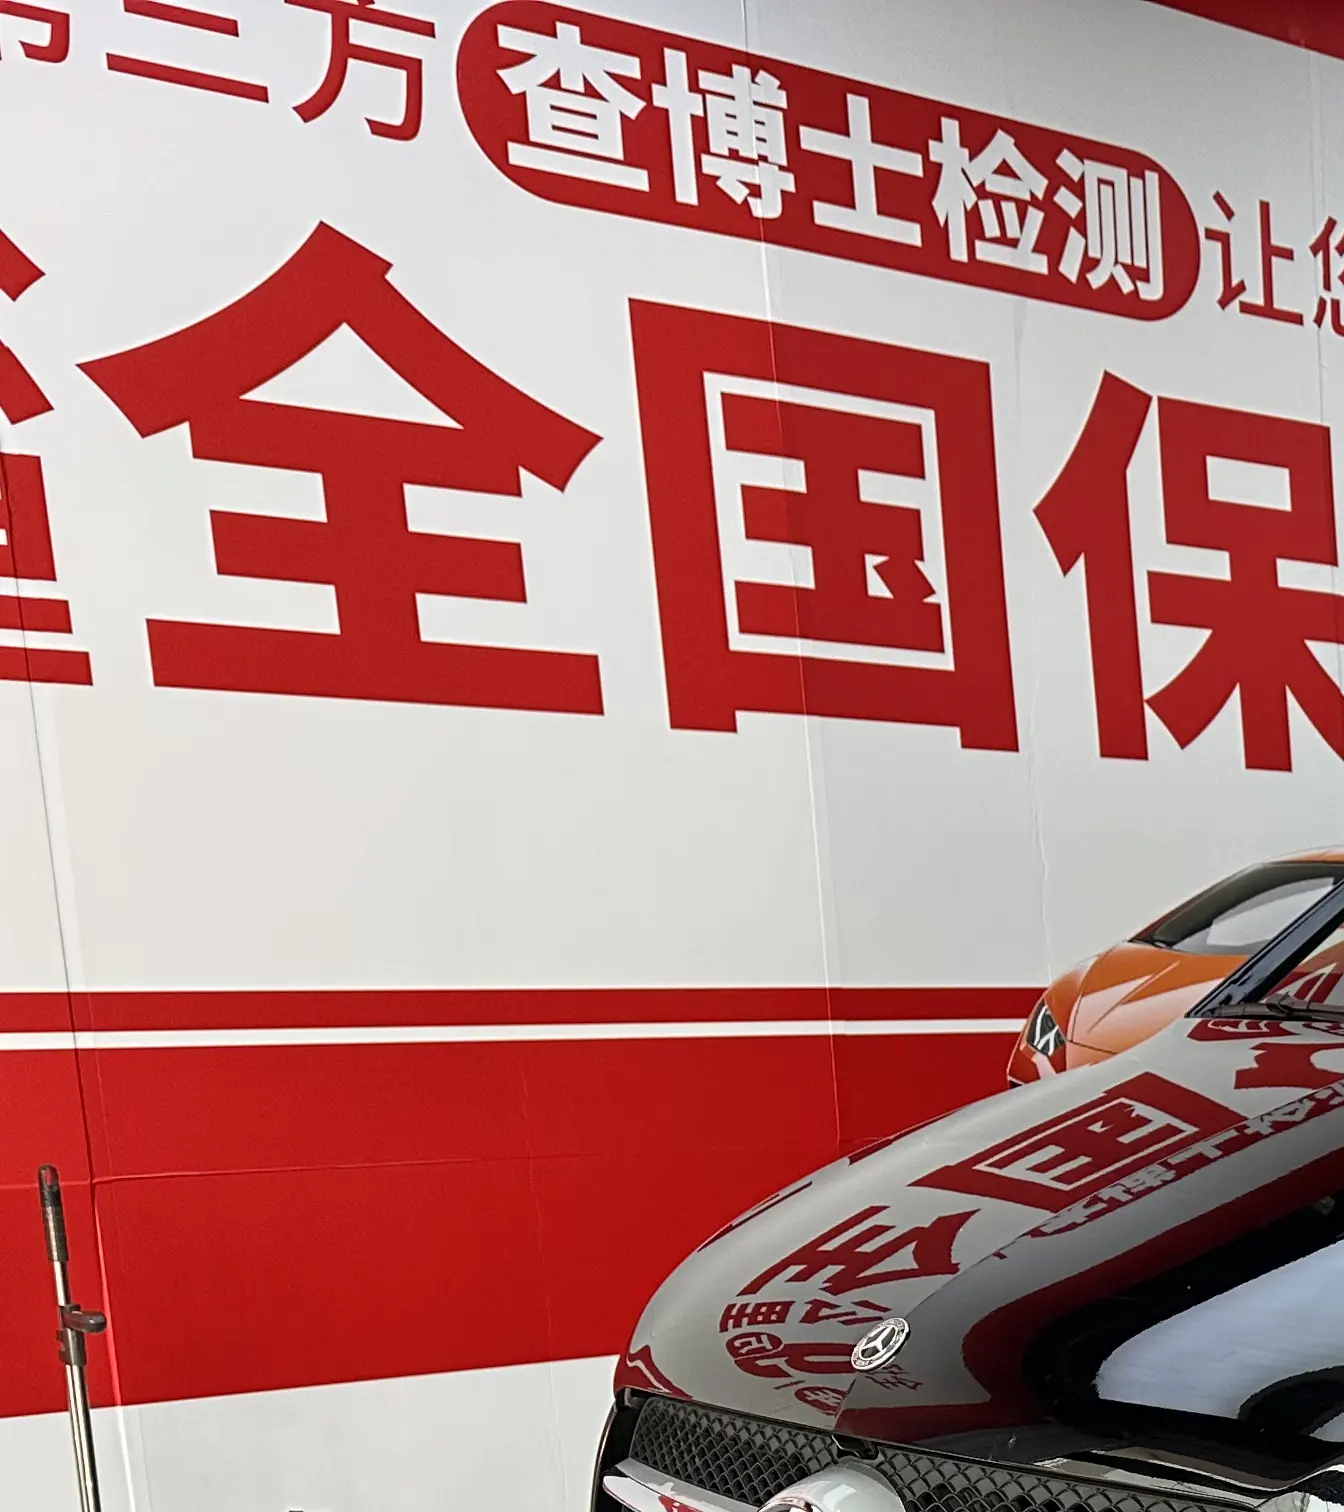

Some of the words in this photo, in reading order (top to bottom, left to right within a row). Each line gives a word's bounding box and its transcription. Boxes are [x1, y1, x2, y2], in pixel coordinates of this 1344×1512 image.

[497, 20, 1163, 302] 查博士检测
